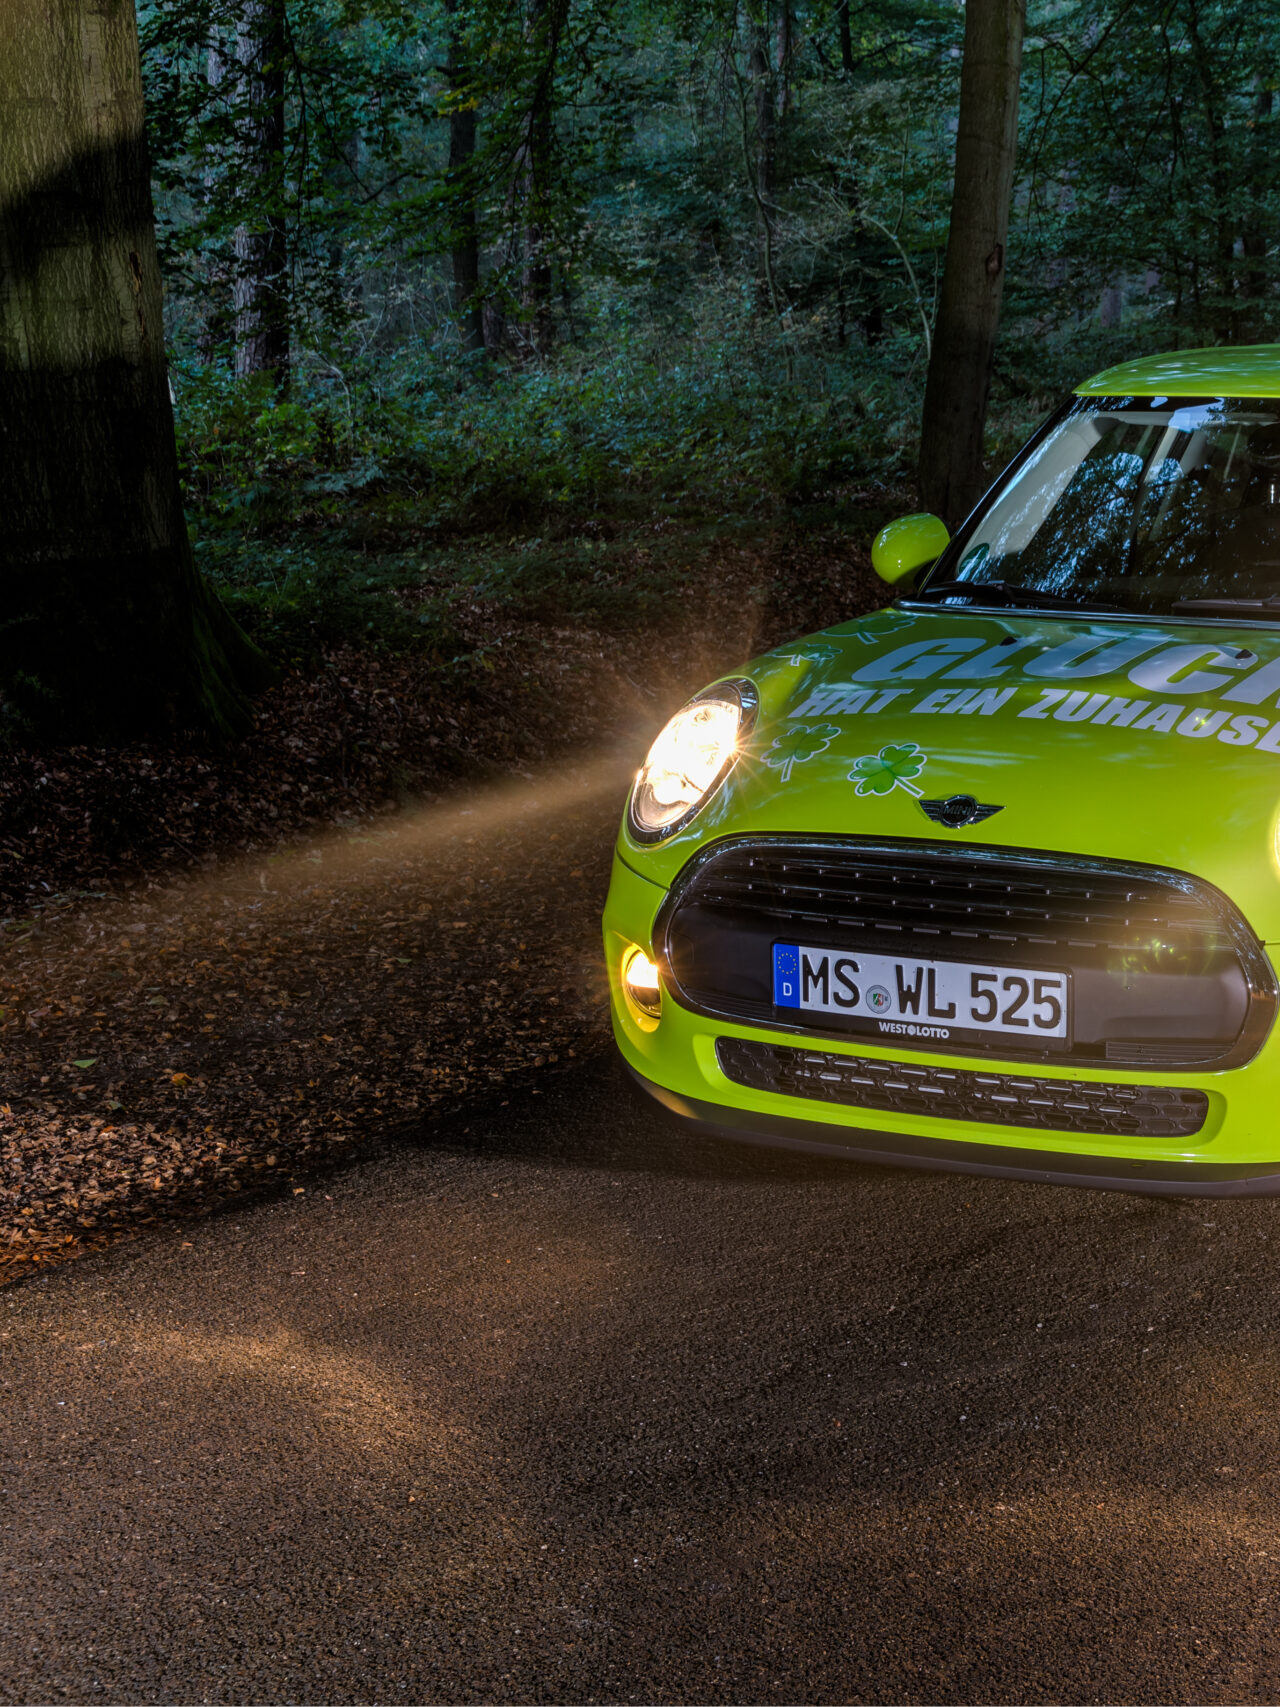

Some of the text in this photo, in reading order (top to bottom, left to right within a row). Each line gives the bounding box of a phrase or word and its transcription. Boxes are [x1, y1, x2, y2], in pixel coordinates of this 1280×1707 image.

[787, 688, 914, 719] HAT
[909, 687, 1019, 715] EIN
[782, 982, 793, 997] D
[802, 954, 1062, 1029] MS WL 525
